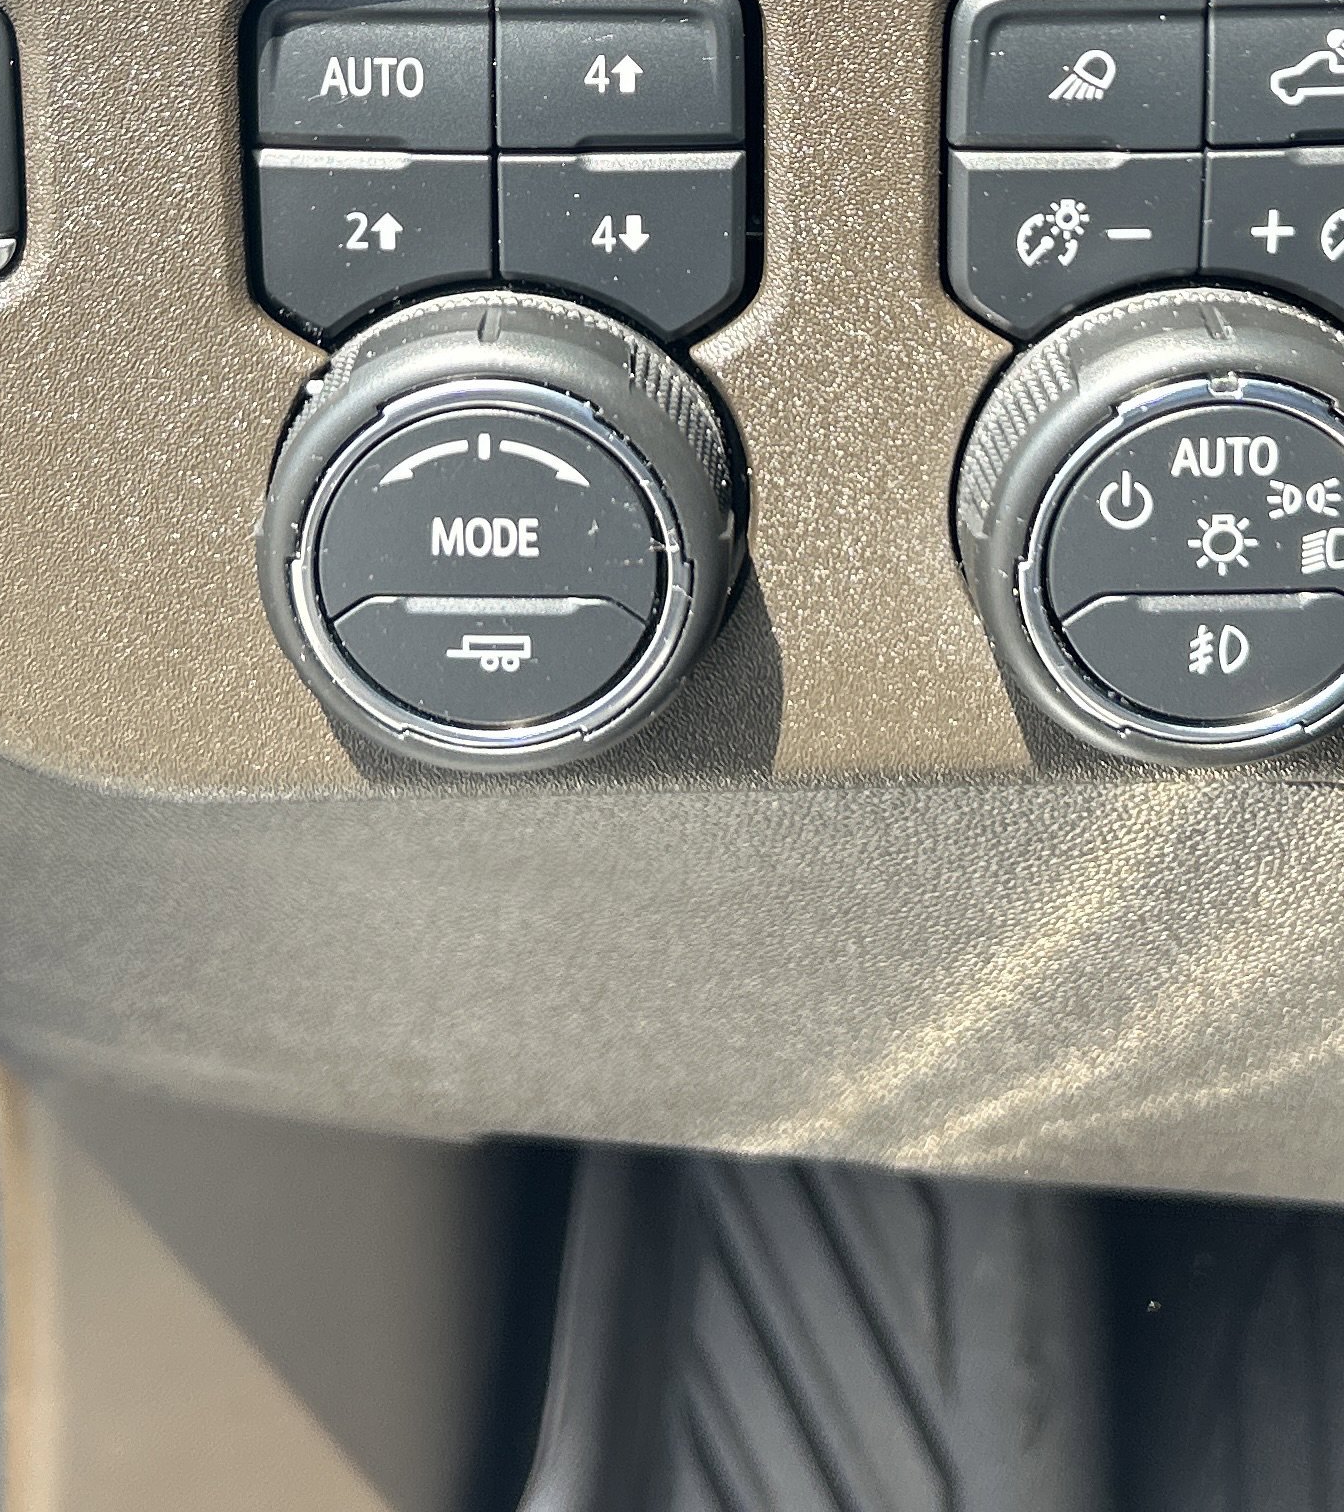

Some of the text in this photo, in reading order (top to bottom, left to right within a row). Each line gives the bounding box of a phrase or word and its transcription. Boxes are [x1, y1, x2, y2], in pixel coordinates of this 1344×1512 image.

[319, 55, 425, 99] AUTO
[1169, 435, 1280, 479] AUTO
[430, 515, 541, 560] MODE
